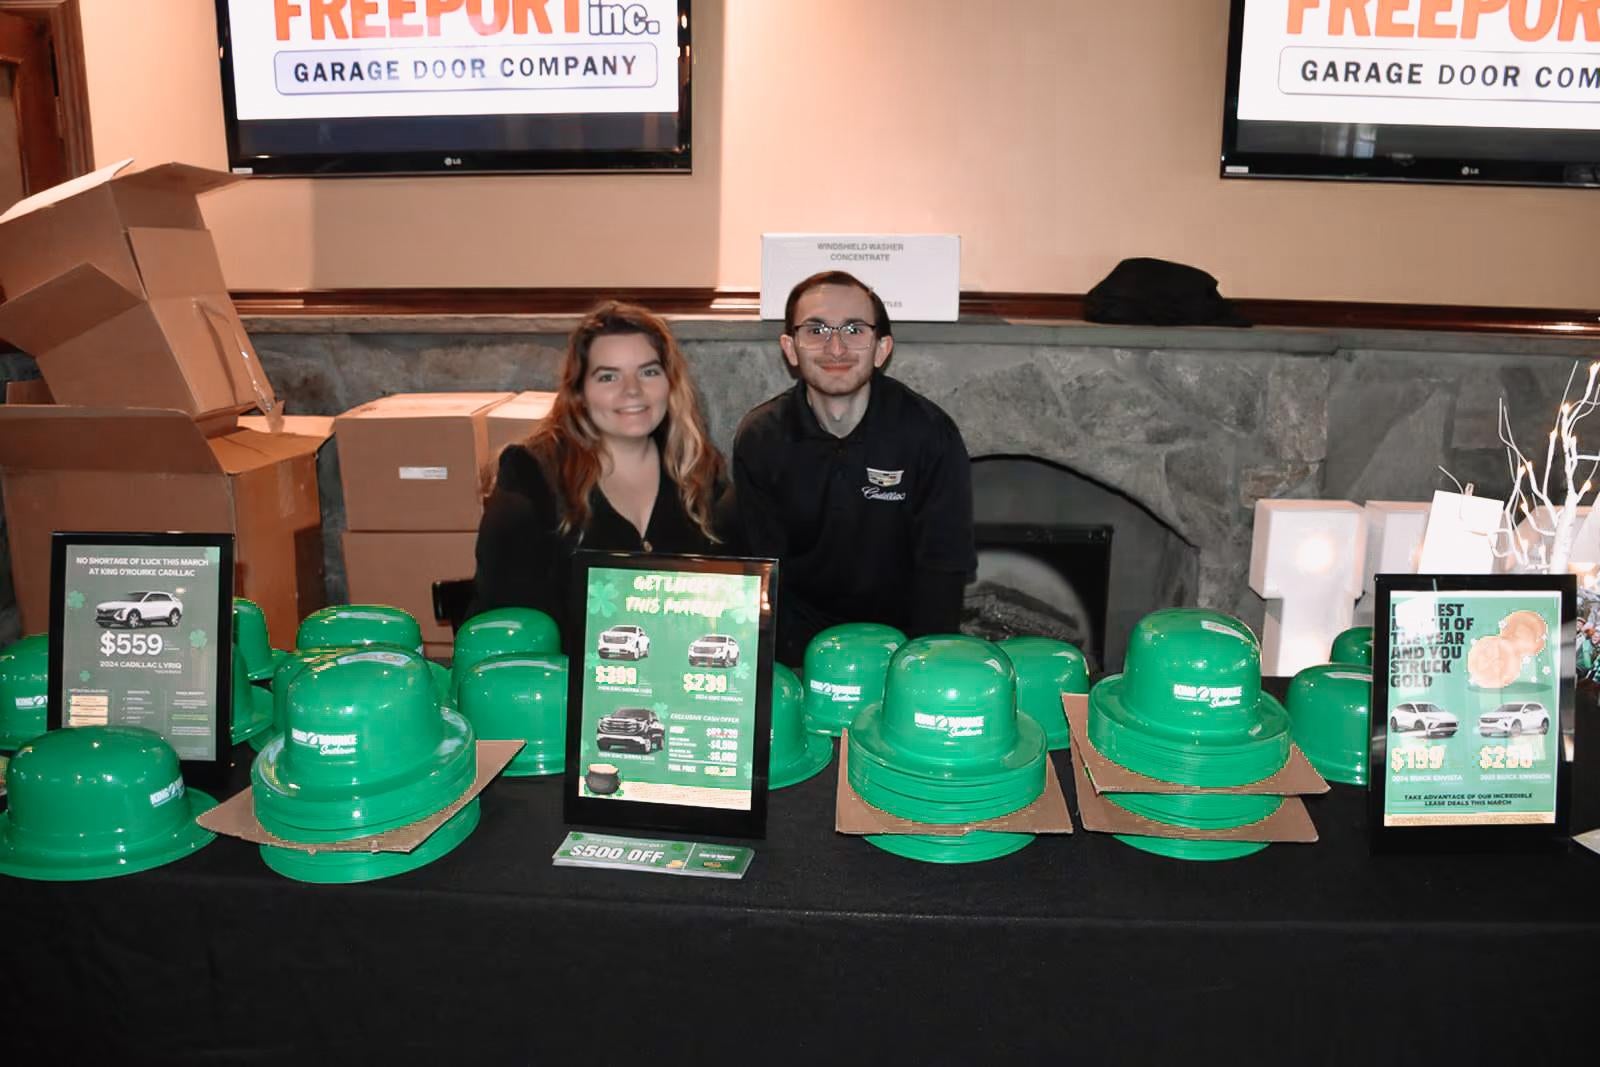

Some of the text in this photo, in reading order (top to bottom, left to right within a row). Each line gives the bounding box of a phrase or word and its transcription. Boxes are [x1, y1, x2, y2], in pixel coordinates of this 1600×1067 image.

[588, 0, 661, 36] inc.
[294, 53, 637, 84] GARAGE DOOR COMPANY
[1300, 59, 1424, 84] GARAGE
[1438, 64, 1521, 87] DOOR
[817, 242, 904, 251] WINDSHIELD WASHER
[830, 253, 891, 261] CONCENTRATE
[76, 557, 209, 567] NO SHORTAGE OF LUCK THIS MARCH
[88, 567, 100, 576] AT
[101, 568, 118, 576] KING
[158, 569, 196, 578] CADILLAC
[1454, 617, 1474, 631] OF
[100, 630, 163, 657] $559
[1426, 631, 1466, 645] YEAR
[1391, 646, 1462, 660] AND YOU
[100, 660, 119, 668] 2024
[120, 661, 157, 669] CADILLAC
[1391, 660, 1452, 674] STRUCK
[1391, 675, 1433, 688] GOLD
[569, 844, 665, 864] $500 OFF
